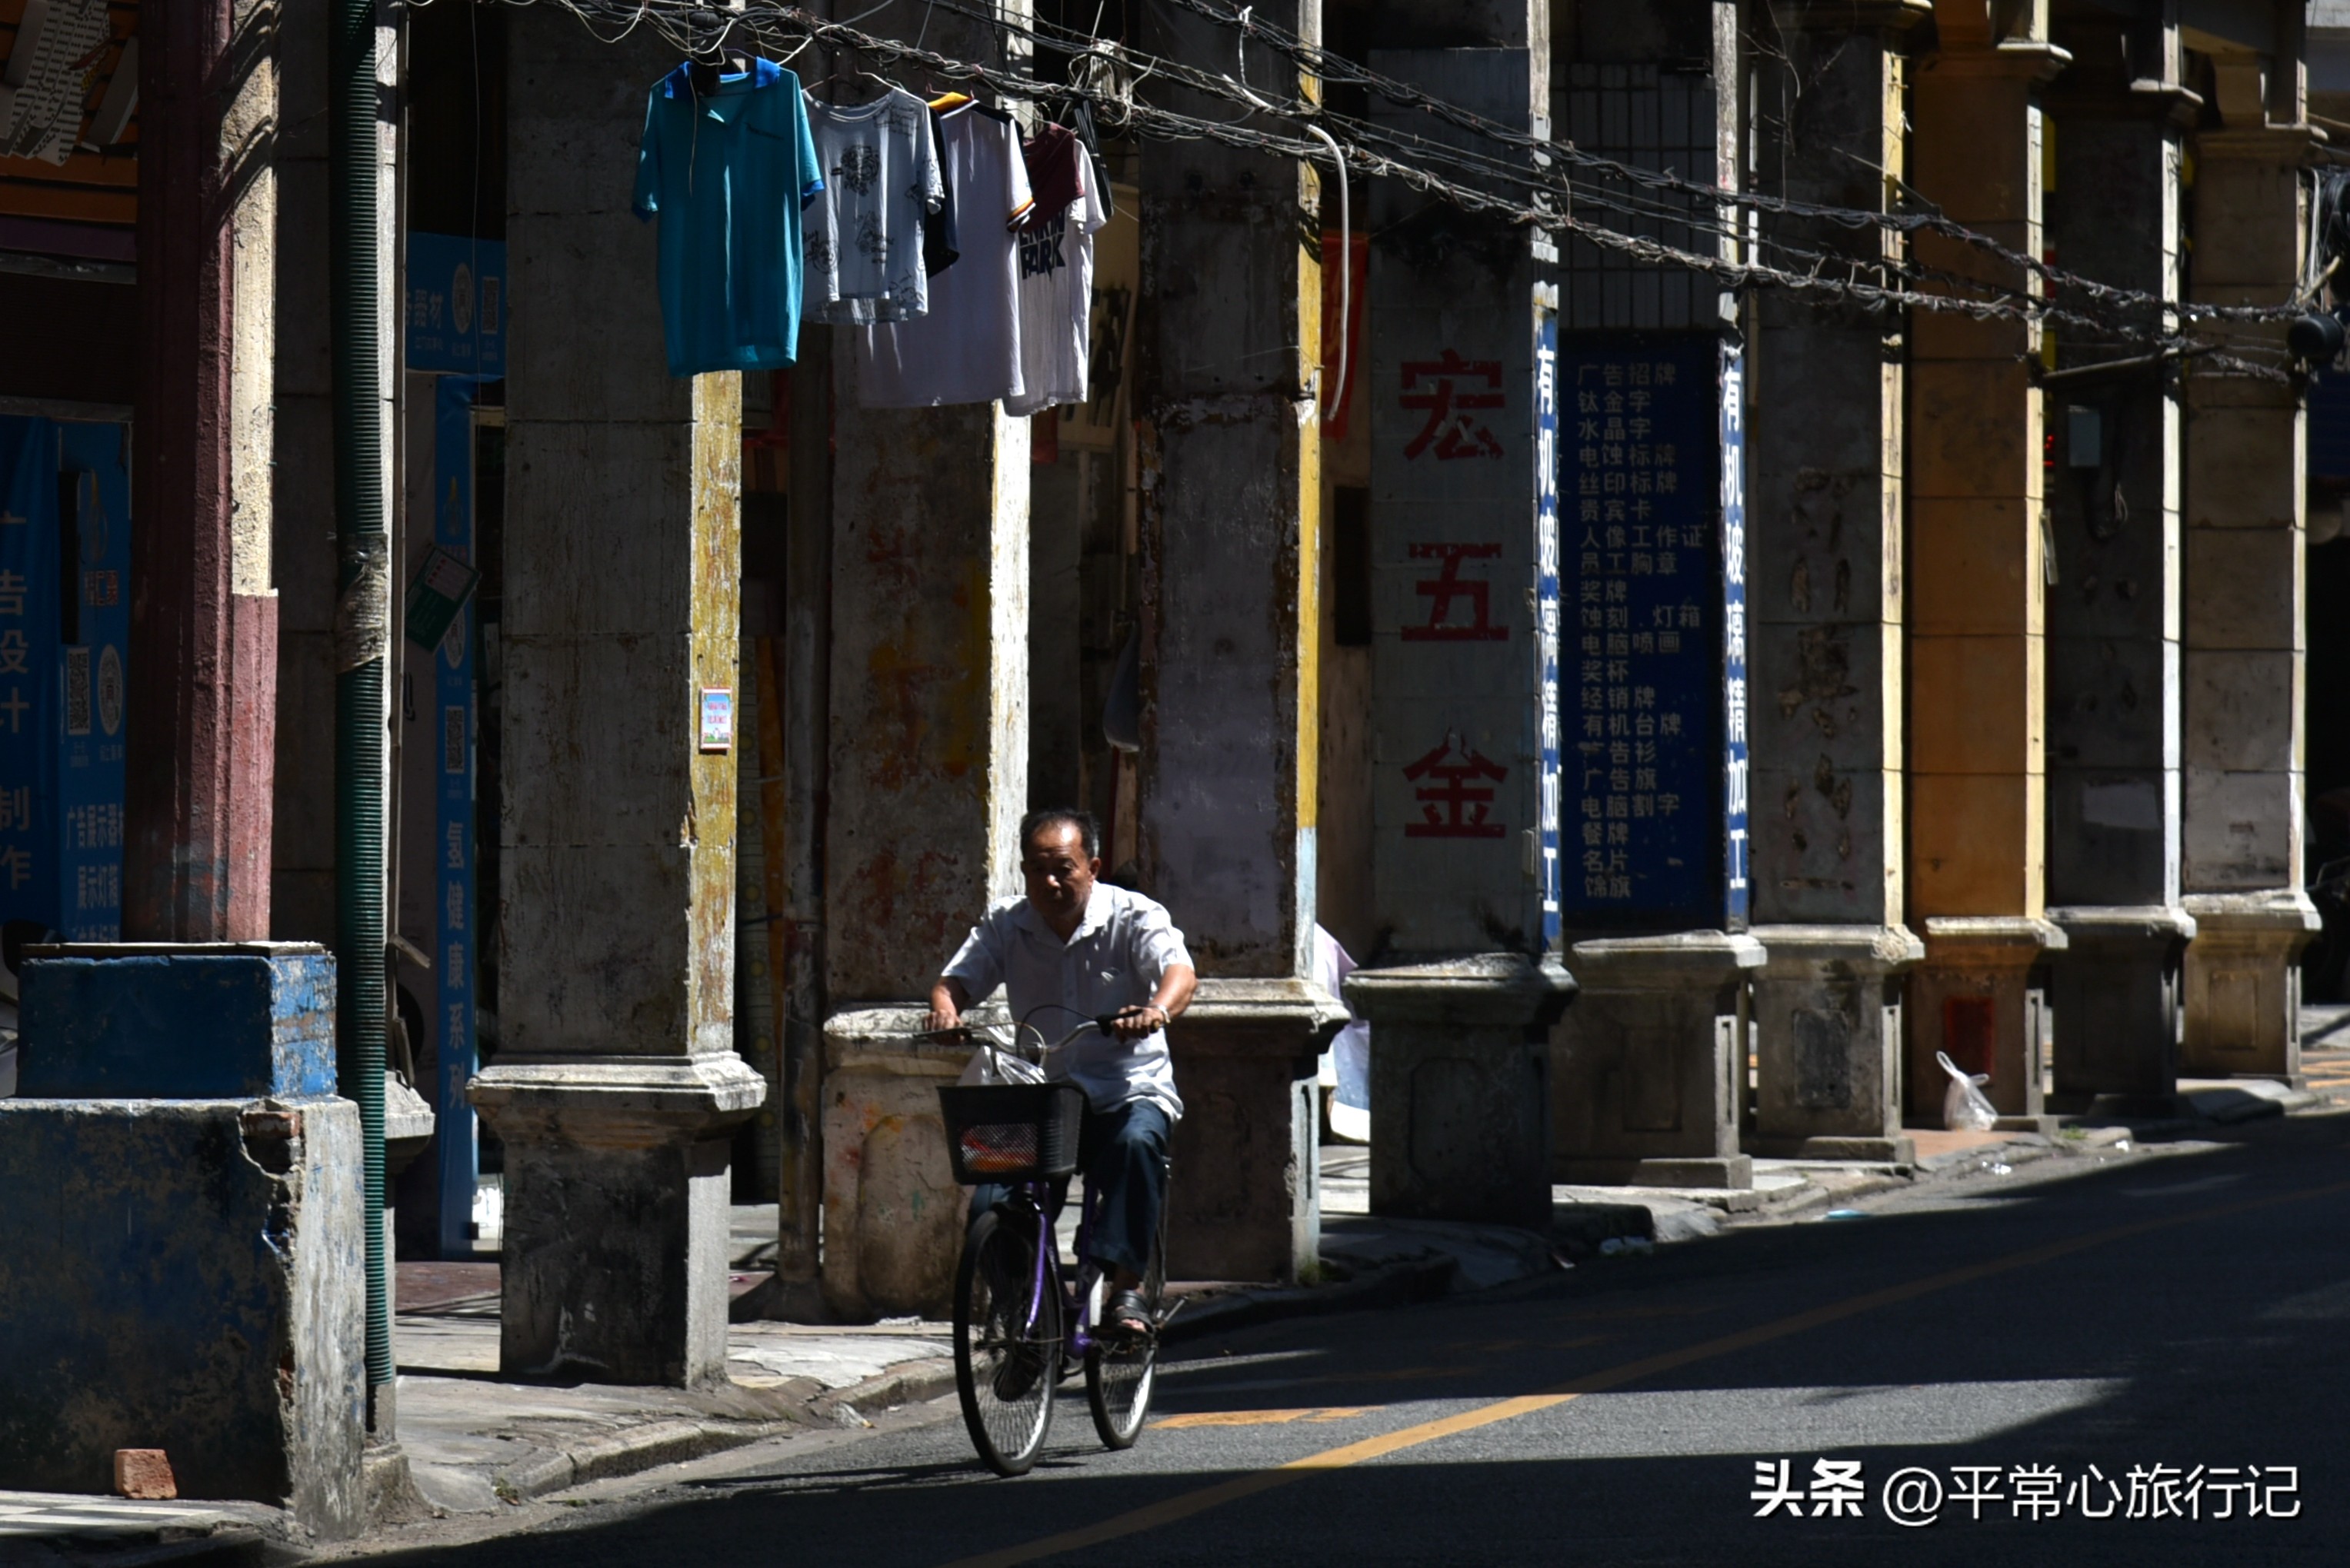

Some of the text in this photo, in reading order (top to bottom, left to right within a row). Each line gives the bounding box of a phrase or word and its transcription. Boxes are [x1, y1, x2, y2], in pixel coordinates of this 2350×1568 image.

[1020, 234, 1066, 281] PARK
[1578, 363, 1676, 387] 广告招牌
[1578, 390, 1651, 414] 钛金字
[1578, 418, 1651, 441] 水晶字
[1579, 444, 1675, 468] 电蚀标牌
[1578, 471, 1677, 494] 丝印标牌
[1579, 499, 1652, 522] 贵宾卡
[1580, 526, 1702, 549] 人像工作证
[1581, 551, 1678, 575] 员工胸章
[1398, 348, 1509, 838] 宏五金
[1581, 580, 1628, 603] 奖牌
[1582, 631, 1681, 656] 电脑喷画
[1582, 660, 1628, 683] 奖杯
[1581, 686, 1655, 710] 经销牌
[1582, 713, 1682, 737] 有机台牌
[1583, 767, 1657, 791] 广告旗
[1581, 793, 1679, 819] 电脑割字
[1582, 821, 1628, 845] 餐牌
[1582, 849, 1628, 873] 名片
